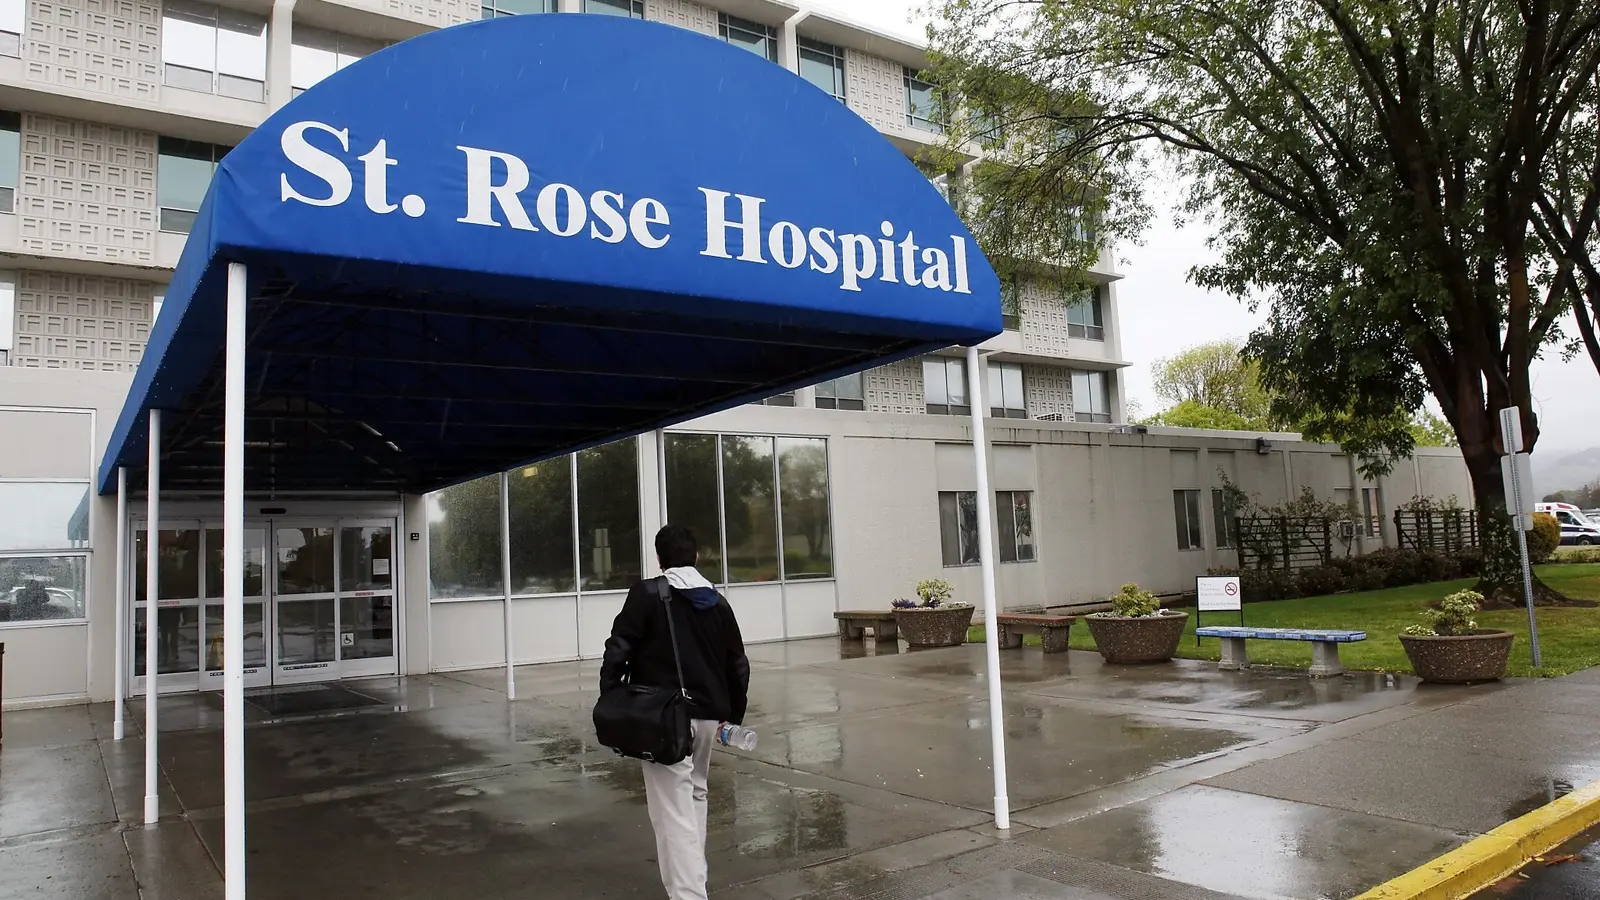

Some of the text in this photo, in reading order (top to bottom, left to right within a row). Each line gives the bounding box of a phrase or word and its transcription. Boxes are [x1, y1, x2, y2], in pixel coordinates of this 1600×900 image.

[279, 120, 972, 294] St. Rose Hospital
